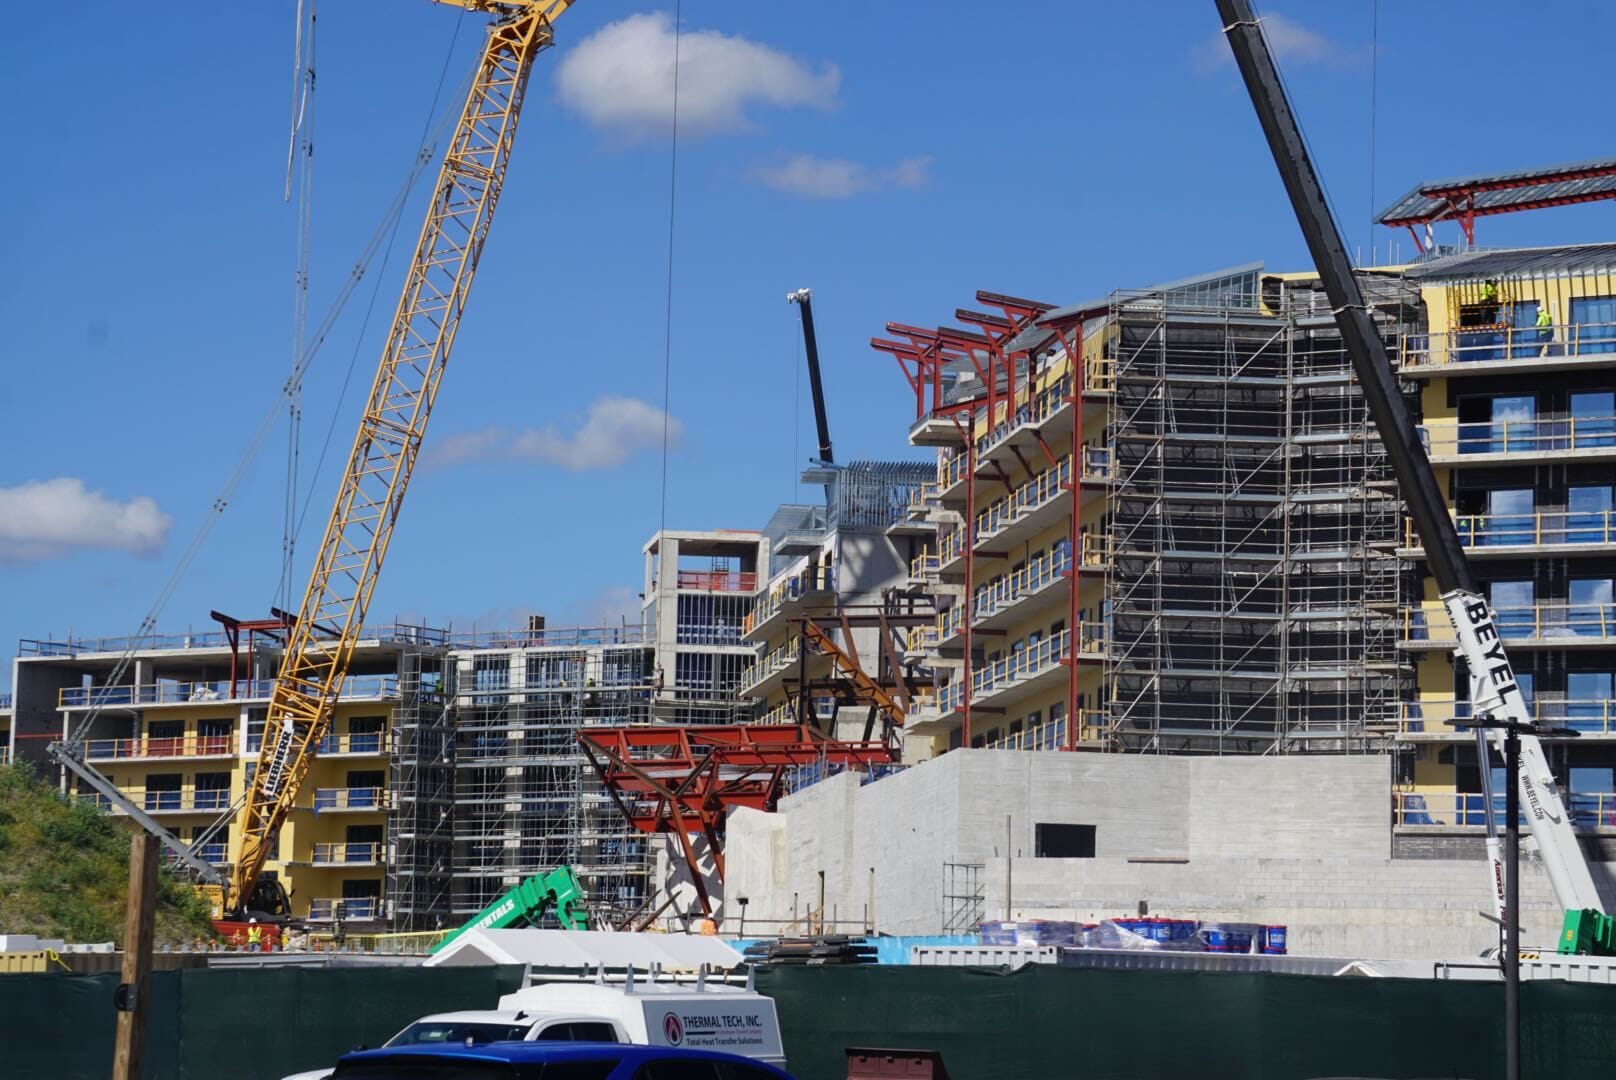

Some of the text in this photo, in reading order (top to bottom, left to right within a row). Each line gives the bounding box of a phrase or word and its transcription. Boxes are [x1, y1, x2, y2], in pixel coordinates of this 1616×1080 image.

[1465, 601, 1517, 704] BEYEL
[265, 730, 292, 792] LIEBHERR
[1521, 774, 1545, 821] WWW.BEYEL.COM
[682, 1015, 762, 1028] THERMAL TECH, INC.
[686, 1036, 763, 1046] Total Heat Transfer Solutions
